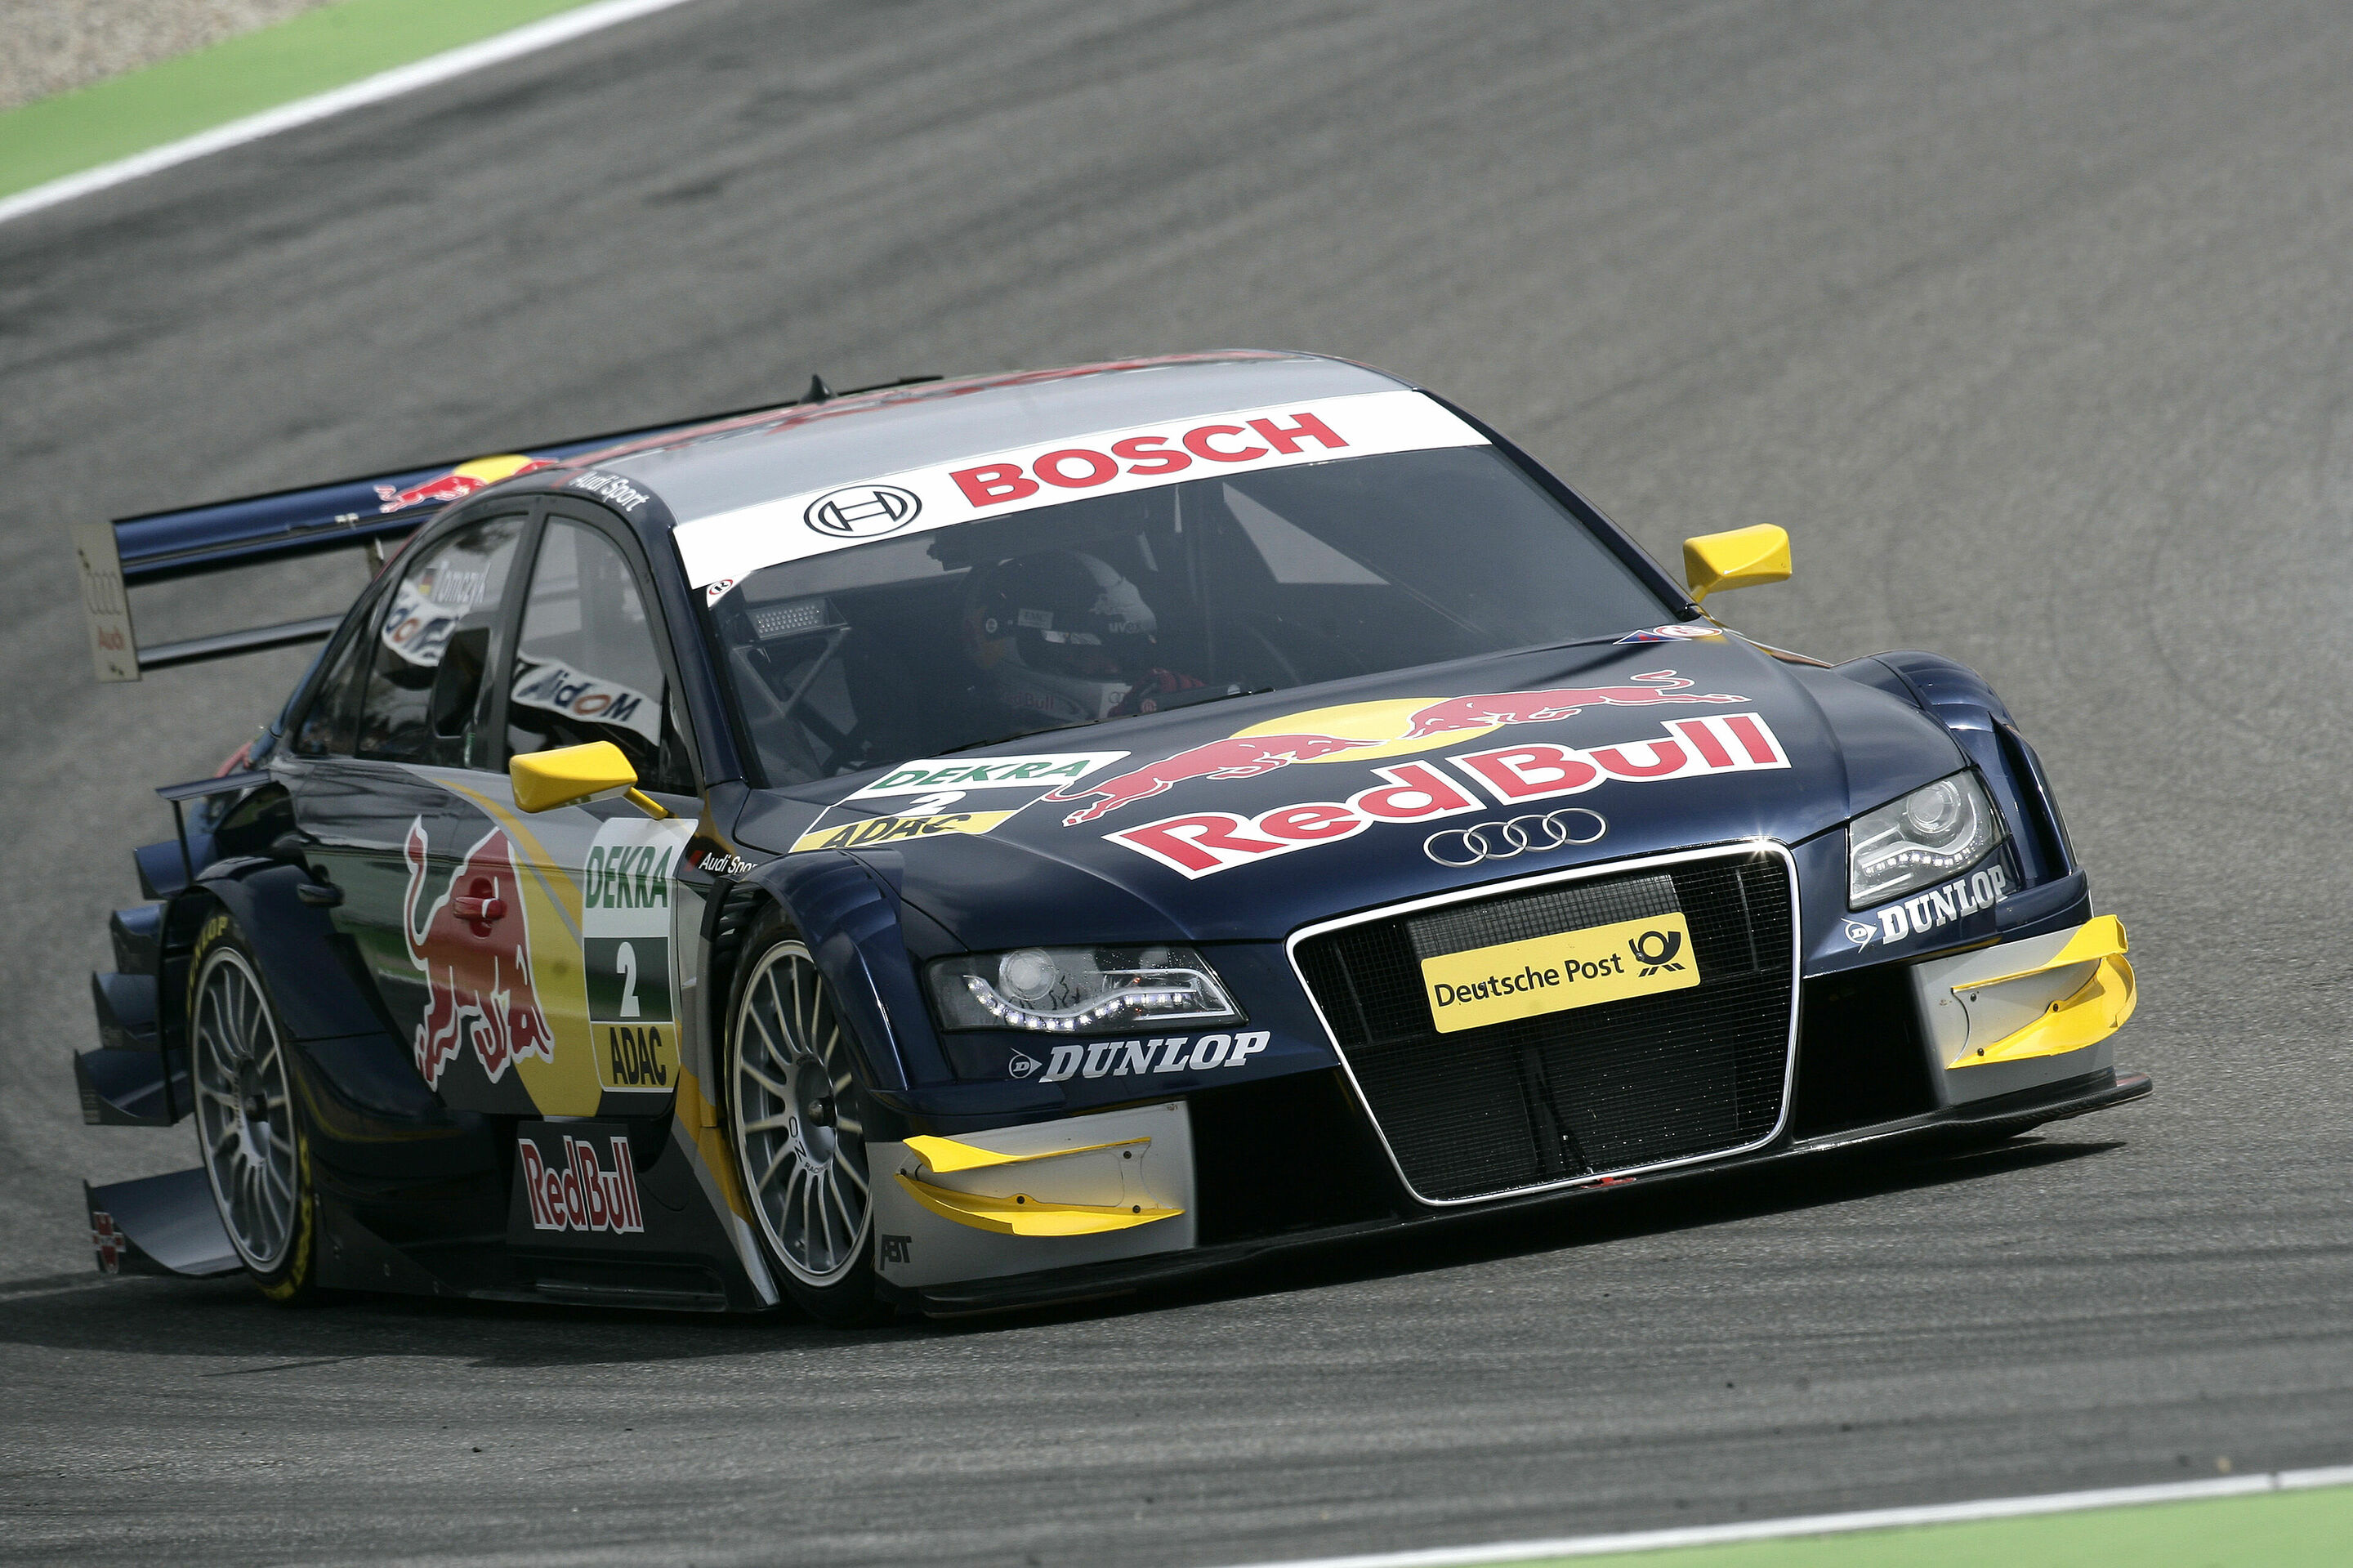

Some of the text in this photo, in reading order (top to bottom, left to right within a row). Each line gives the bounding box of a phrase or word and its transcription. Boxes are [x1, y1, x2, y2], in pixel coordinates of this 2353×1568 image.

[949, 412, 1350, 507] BOSCH
[569, 471, 650, 512] Audi Sport
[1025, 693, 1055, 711] Bull
[868, 759, 1091, 790] DEKRA
[1113, 714, 1784, 874] Red Bull
[897, 790, 967, 816] 2
[818, 814, 971, 849] ADAC
[585, 846, 668, 909] DEKRA
[698, 851, 732, 873] Audi
[1877, 864, 2008, 945] DUNLOP
[616, 941, 641, 1017] 2
[1434, 953, 1625, 1007] Deutsche Post
[609, 1026, 667, 1086] ADAC
[1038, 1031, 1270, 1083] DUNLOP
[520, 1137, 644, 1234] Red Bull
[880, 1234, 912, 1271] ABT
